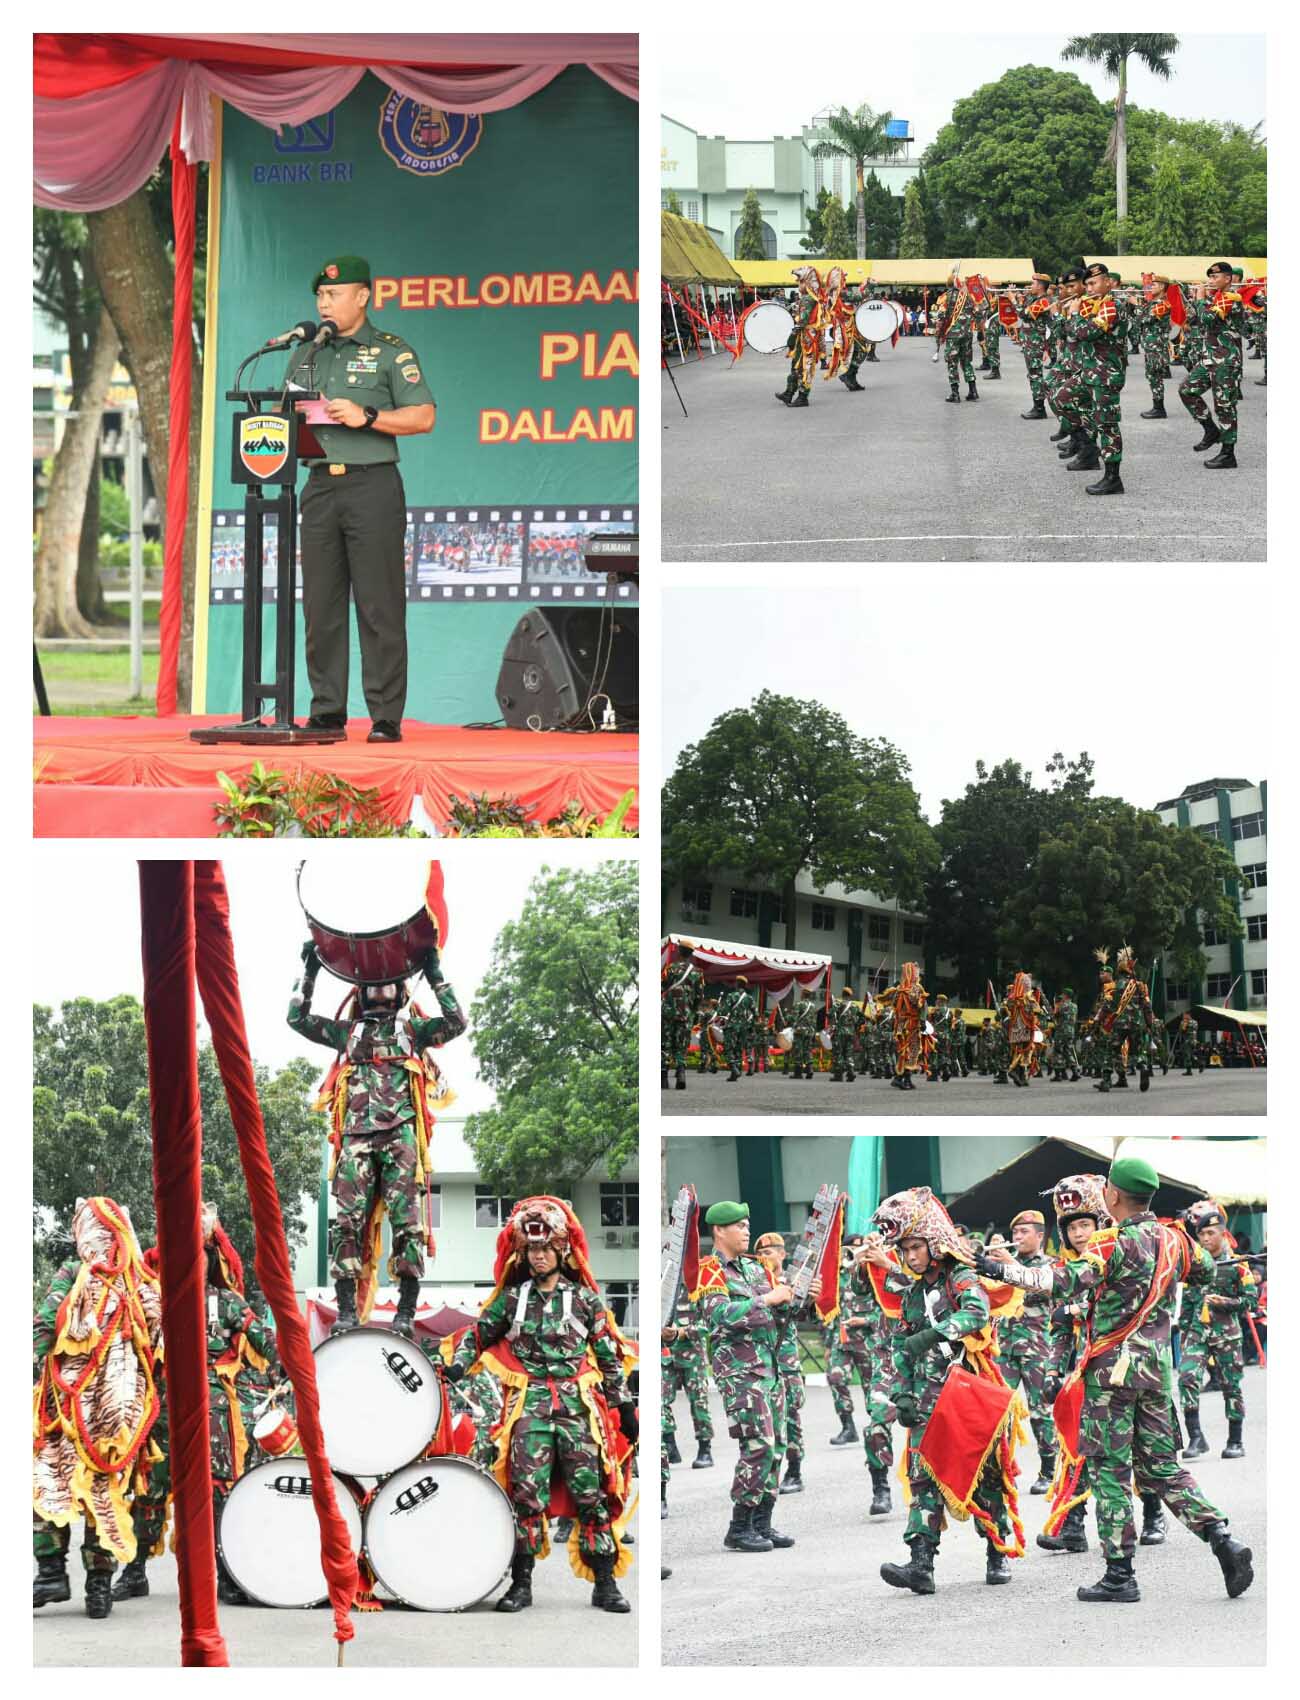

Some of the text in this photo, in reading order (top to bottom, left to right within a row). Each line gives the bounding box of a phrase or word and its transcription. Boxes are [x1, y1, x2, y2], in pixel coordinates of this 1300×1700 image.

[253, 162, 353, 184] BANK BRI
[400, 152, 460, 170] INDONESIA
[540, 331, 639, 380] PIA
[479, 405, 636, 444] DALAM
